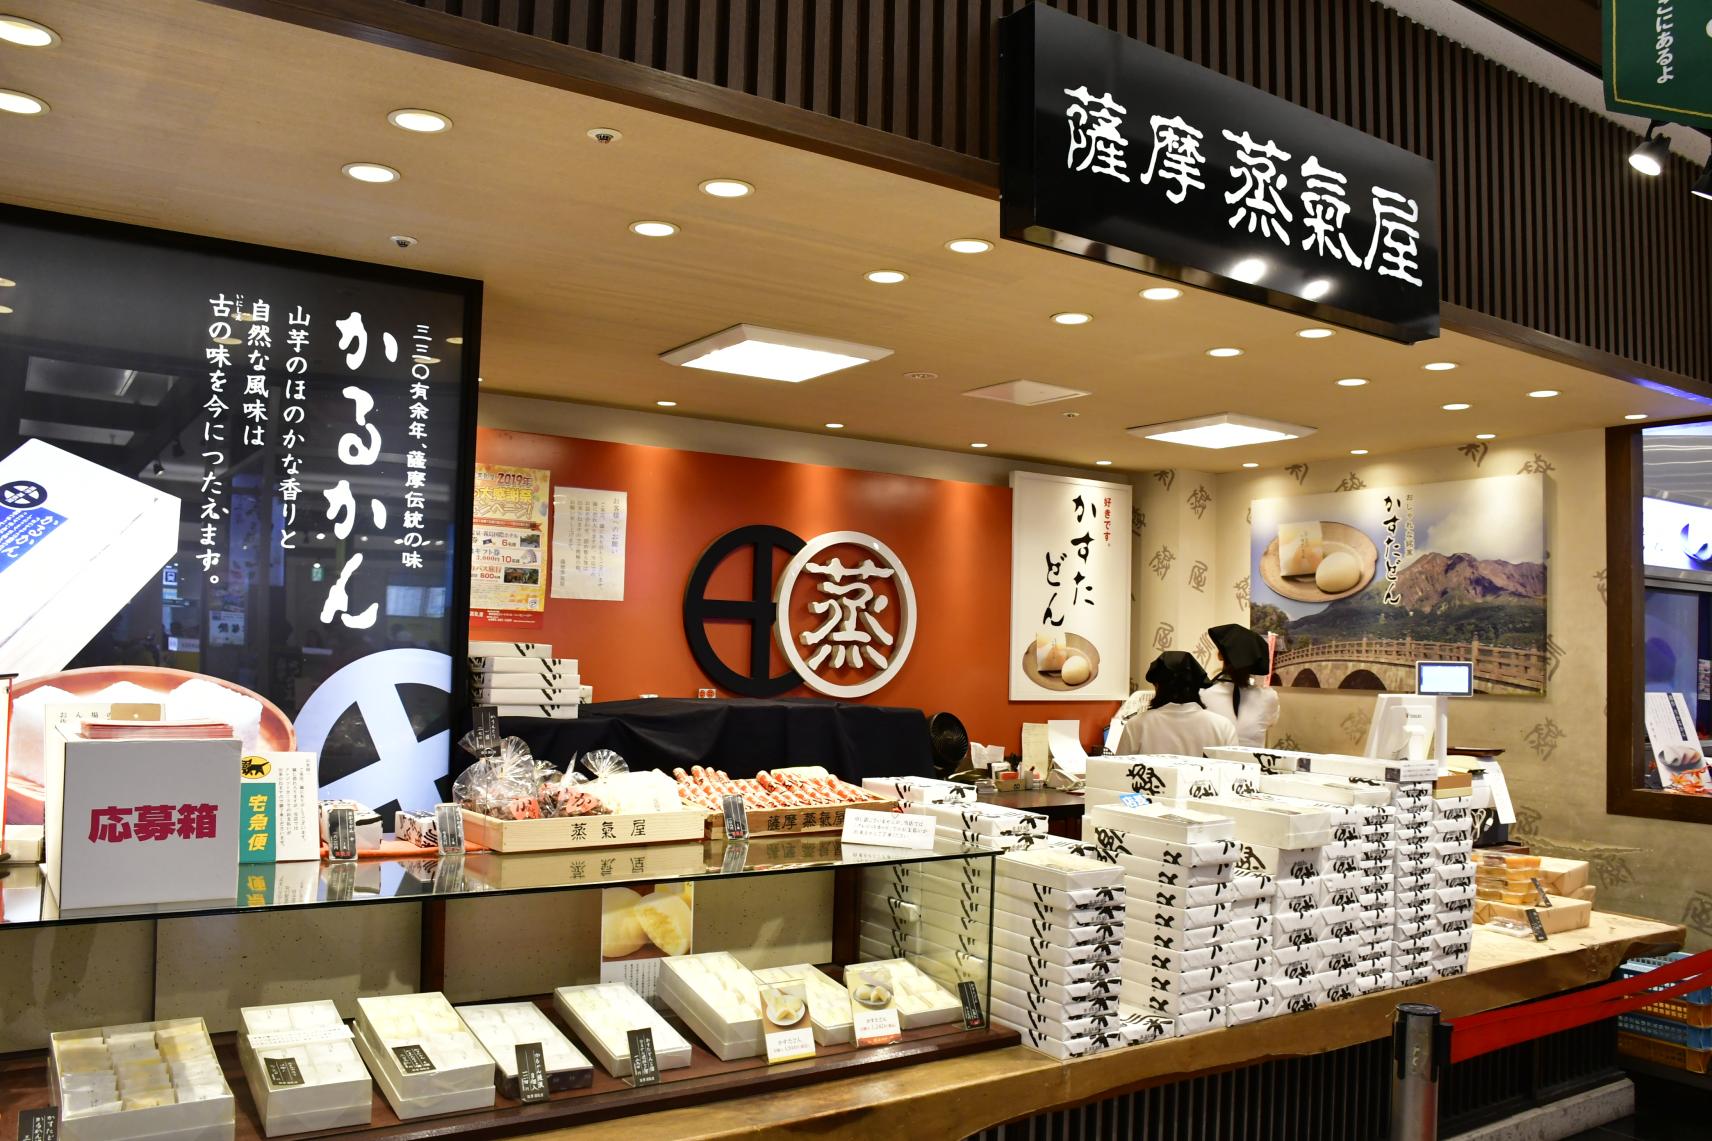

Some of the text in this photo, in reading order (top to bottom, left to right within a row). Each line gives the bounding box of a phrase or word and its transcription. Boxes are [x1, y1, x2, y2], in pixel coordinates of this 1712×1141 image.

[1064, 86, 1424, 288] 薩摩蒸氣屋
[196, 293, 235, 585] 古の味を今につたえます。
[243, 299, 271, 447] 自然な風味は
[279, 305, 311, 550] 山芋のほのかな香りと
[320, 311, 399, 629] かるかん
[1382, 494, 1401, 606] かすたどん
[88, 803, 219, 844] 応募箱
[247, 794, 268, 852] 宅急便
[570, 818, 647, 842] 蒸氣屋
